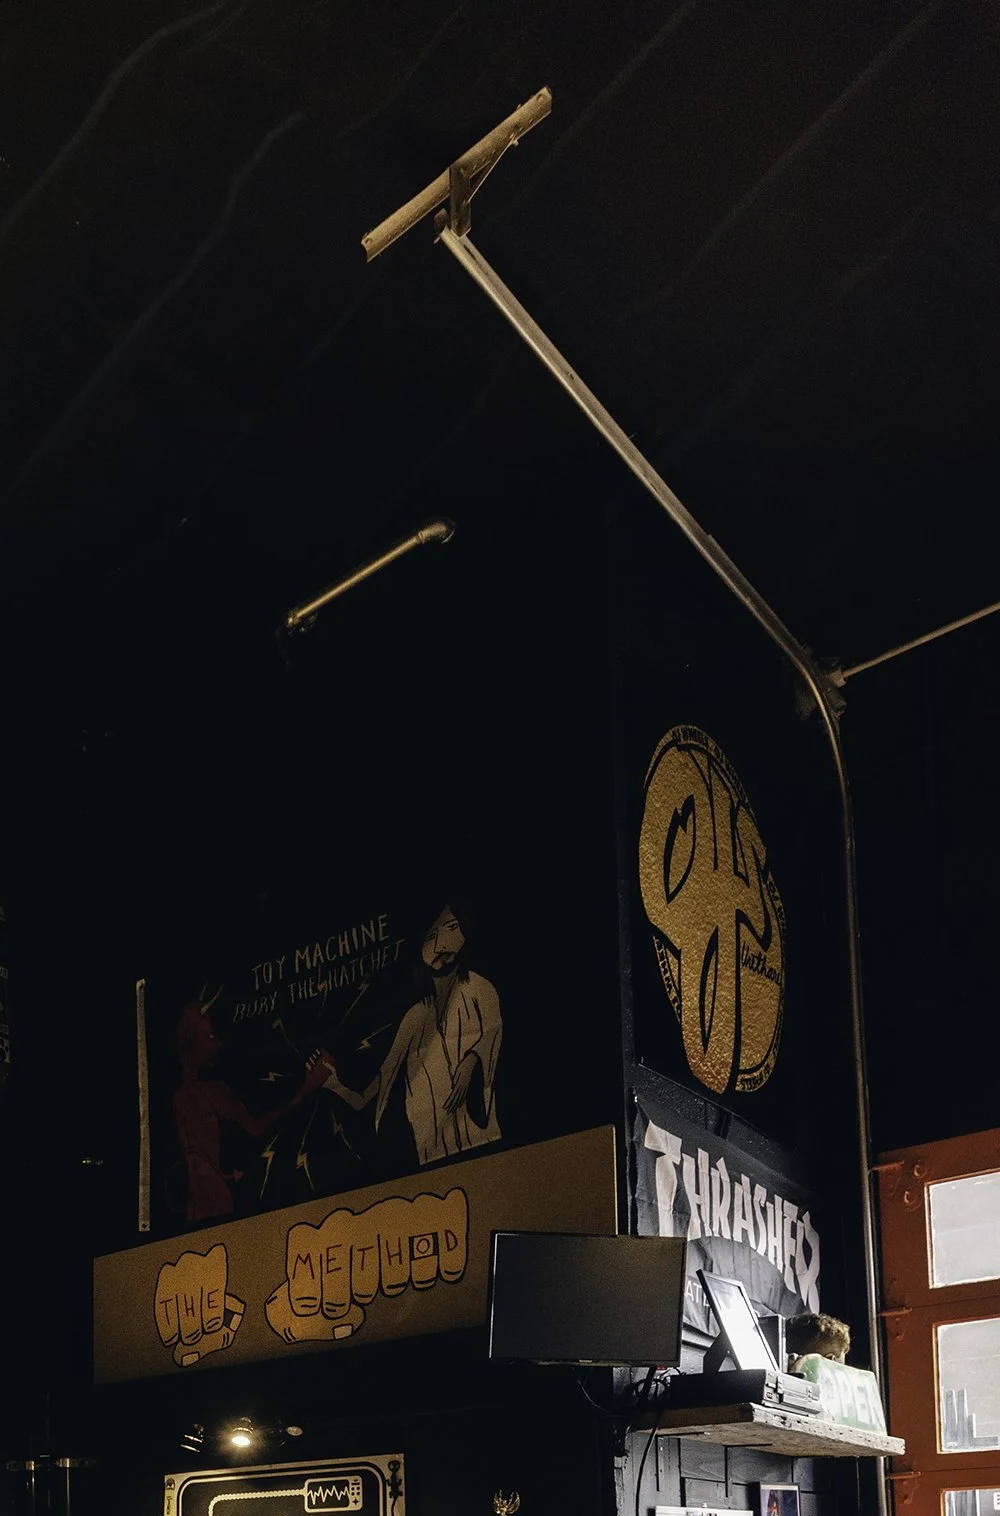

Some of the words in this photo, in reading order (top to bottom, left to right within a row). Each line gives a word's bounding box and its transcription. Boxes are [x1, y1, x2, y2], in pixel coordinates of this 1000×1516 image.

[232, 990, 278, 1023] BURY
[288, 976, 319, 1004] THE
[327, 937, 406, 992] HATCHET
[252, 955, 286, 991] TOY
[295, 912, 391, 973] MACHINE
[643, 1119, 820, 1316] THRASHER
[160, 1288, 220, 1326] THE
[292, 1228, 459, 1281] METHOD
